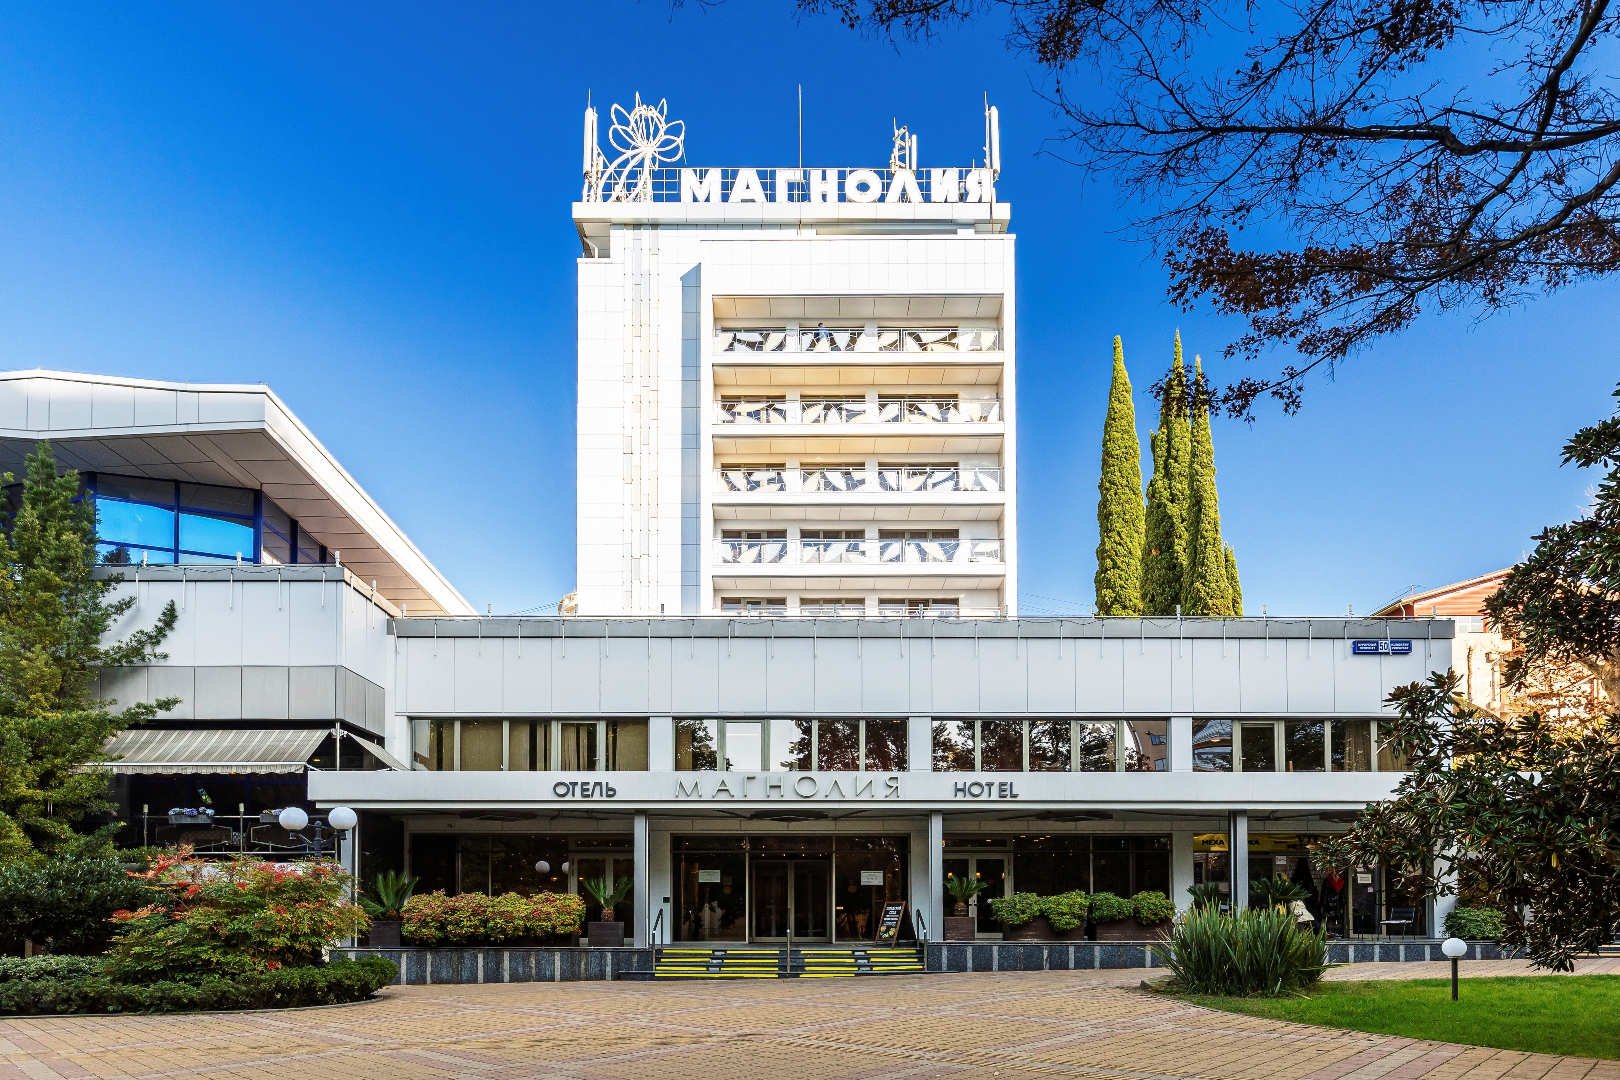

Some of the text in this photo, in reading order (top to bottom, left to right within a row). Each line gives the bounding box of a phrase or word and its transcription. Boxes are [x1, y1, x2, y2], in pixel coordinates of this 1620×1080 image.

[680, 168, 994, 203] МАГНОЛИЯ
[1379, 641, 1389, 651] 50
[553, 780, 617, 799] ОТЕЛЬ
[674, 775, 902, 799] МАГНОЛИЯ
[954, 780, 1019, 799] HOTEL
